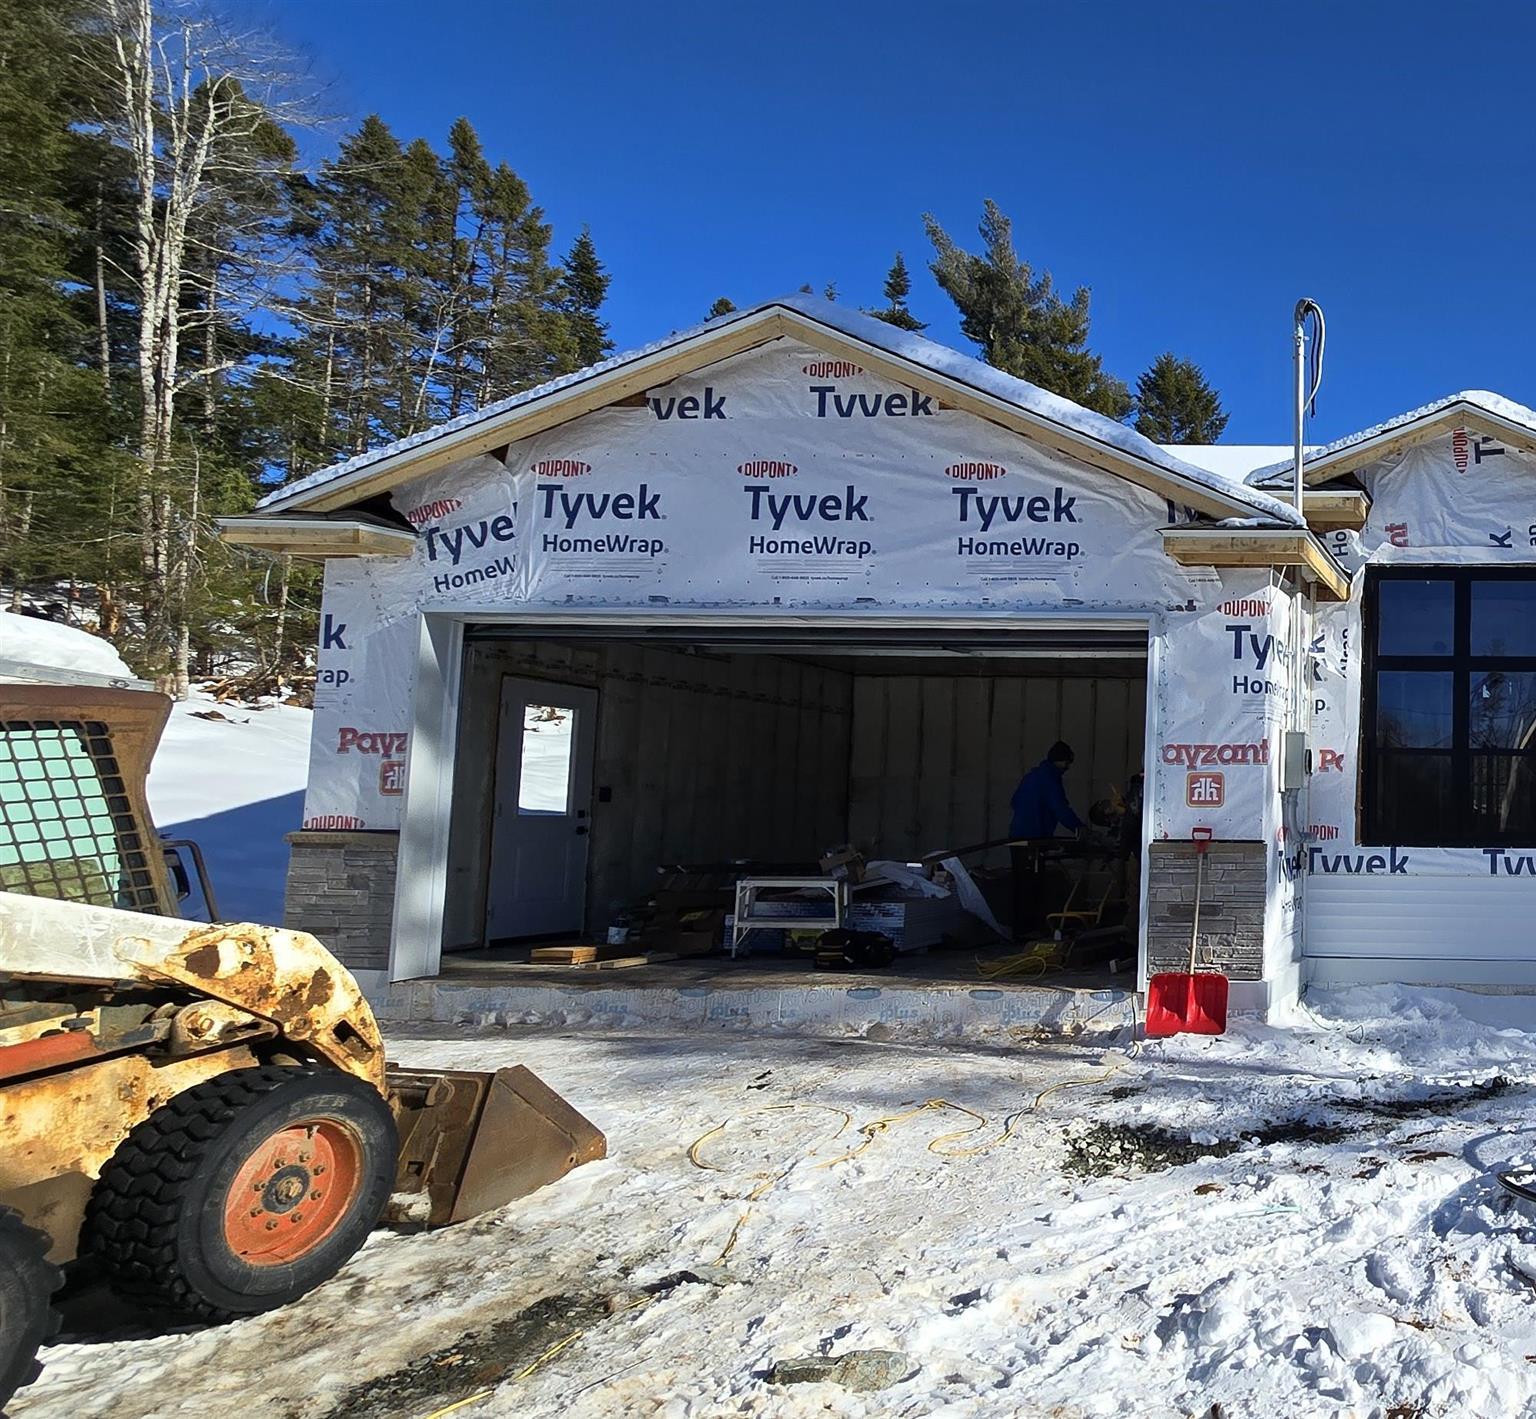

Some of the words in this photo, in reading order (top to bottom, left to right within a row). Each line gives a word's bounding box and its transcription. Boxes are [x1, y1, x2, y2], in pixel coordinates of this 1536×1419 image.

[809, 361, 856, 378] DUPONT
[652, 387, 727, 420] vek
[538, 461, 586, 478] DUPONT
[744, 461, 791, 479] DUPONT
[951, 463, 999, 480] DUPONT
[408, 499, 457, 524] DUPONT
[536, 484, 662, 529] Tyvek
[743, 485, 869, 530] Tyvek
[951, 487, 1077, 532] Tyvek
[427, 501, 518, 566] Tyve
[542, 534, 664, 559] HomeWrap
[749, 536, 872, 560] HomeWrap
[957, 537, 1080, 560] HomeWrap
[433, 554, 516, 593] HomeW
[337, 727, 408, 759] Payz
[1162, 739, 1270, 771] ayzant
